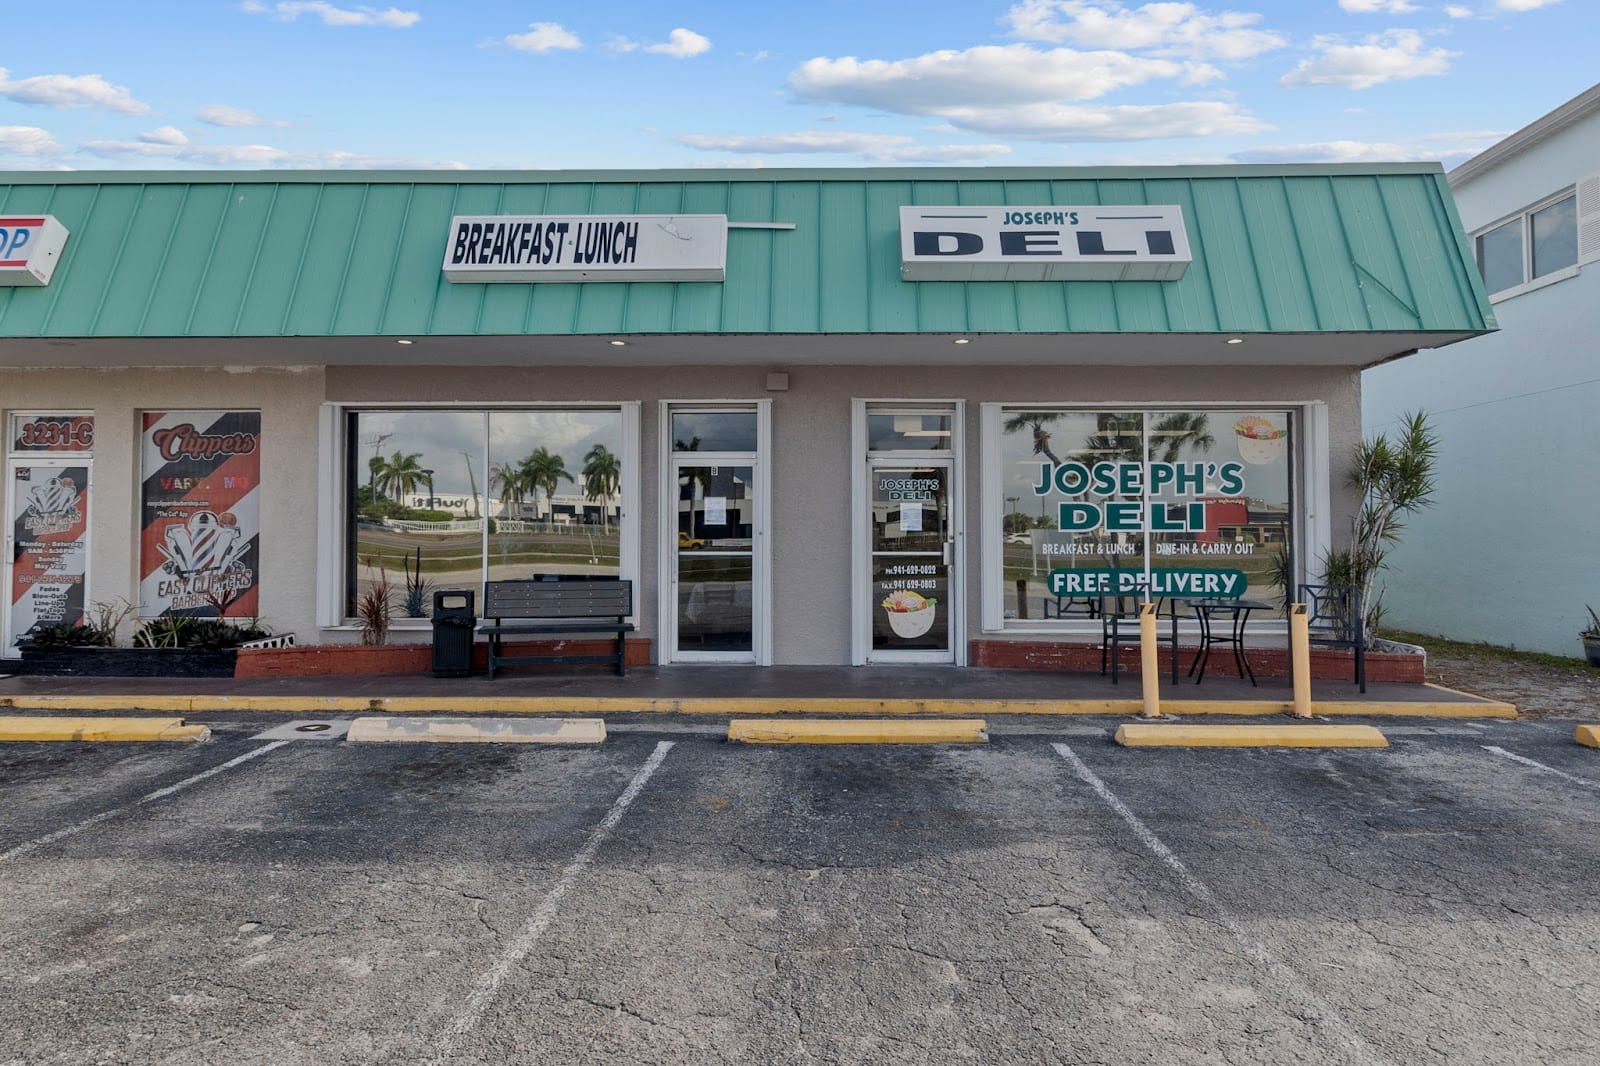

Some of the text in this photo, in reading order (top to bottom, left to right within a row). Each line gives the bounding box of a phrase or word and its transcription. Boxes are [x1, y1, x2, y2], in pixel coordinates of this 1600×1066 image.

[1003, 212, 1079, 226] JOSEPH'S
[452, 221, 569, 265] BREAKFAST
[573, 221, 639, 265] LUNCH
[913, 230, 1176, 256] DELI
[22, 422, 93, 446] 3231-C
[152, 423, 255, 462] Clippers
[880, 479, 939, 490] JOSEPH'S
[1032, 461, 1244, 496] JOSEPH'S
[889, 490, 931, 500] DELI
[1058, 501, 1207, 532] DELI
[1042, 543, 1254, 555] BREAKFAST & LUNCH DINE-IN & CARRY OUT
[158, 579, 188, 597] EASY
[1053, 573, 1238, 594] FREE DELIVERY
